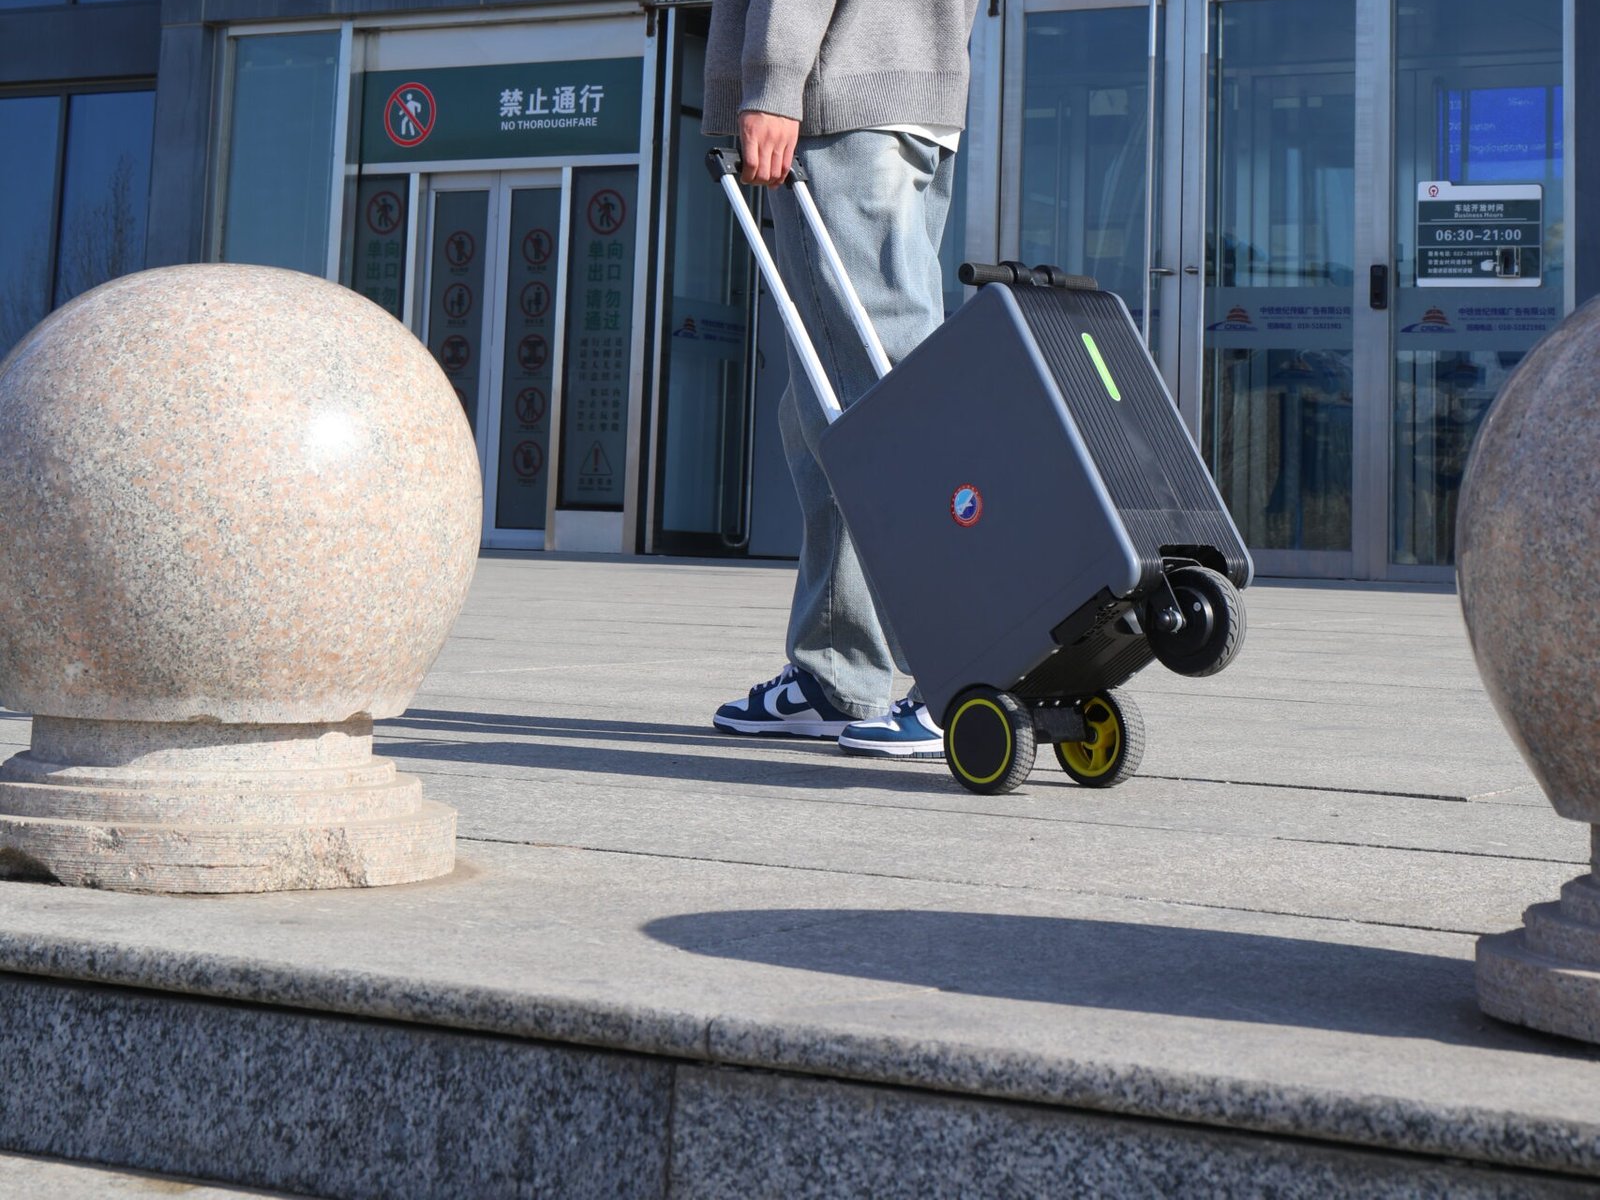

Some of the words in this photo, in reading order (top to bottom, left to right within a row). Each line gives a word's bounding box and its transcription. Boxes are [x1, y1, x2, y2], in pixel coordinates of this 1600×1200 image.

[500, 84, 605, 117] 禁止通行
[501, 120, 516, 131] NO
[518, 117, 598, 130] THOROUGHFARE
[1454, 204, 1504, 212] 车站开放时间
[1436, 229, 1521, 241] 06:30-21:00
[368, 239, 400, 259] 单向
[587, 240, 624, 260] 单向
[366, 262, 397, 280] 出口
[587, 264, 622, 282] 出口
[585, 288, 621, 308] 请勿
[584, 311, 620, 331] 通过
